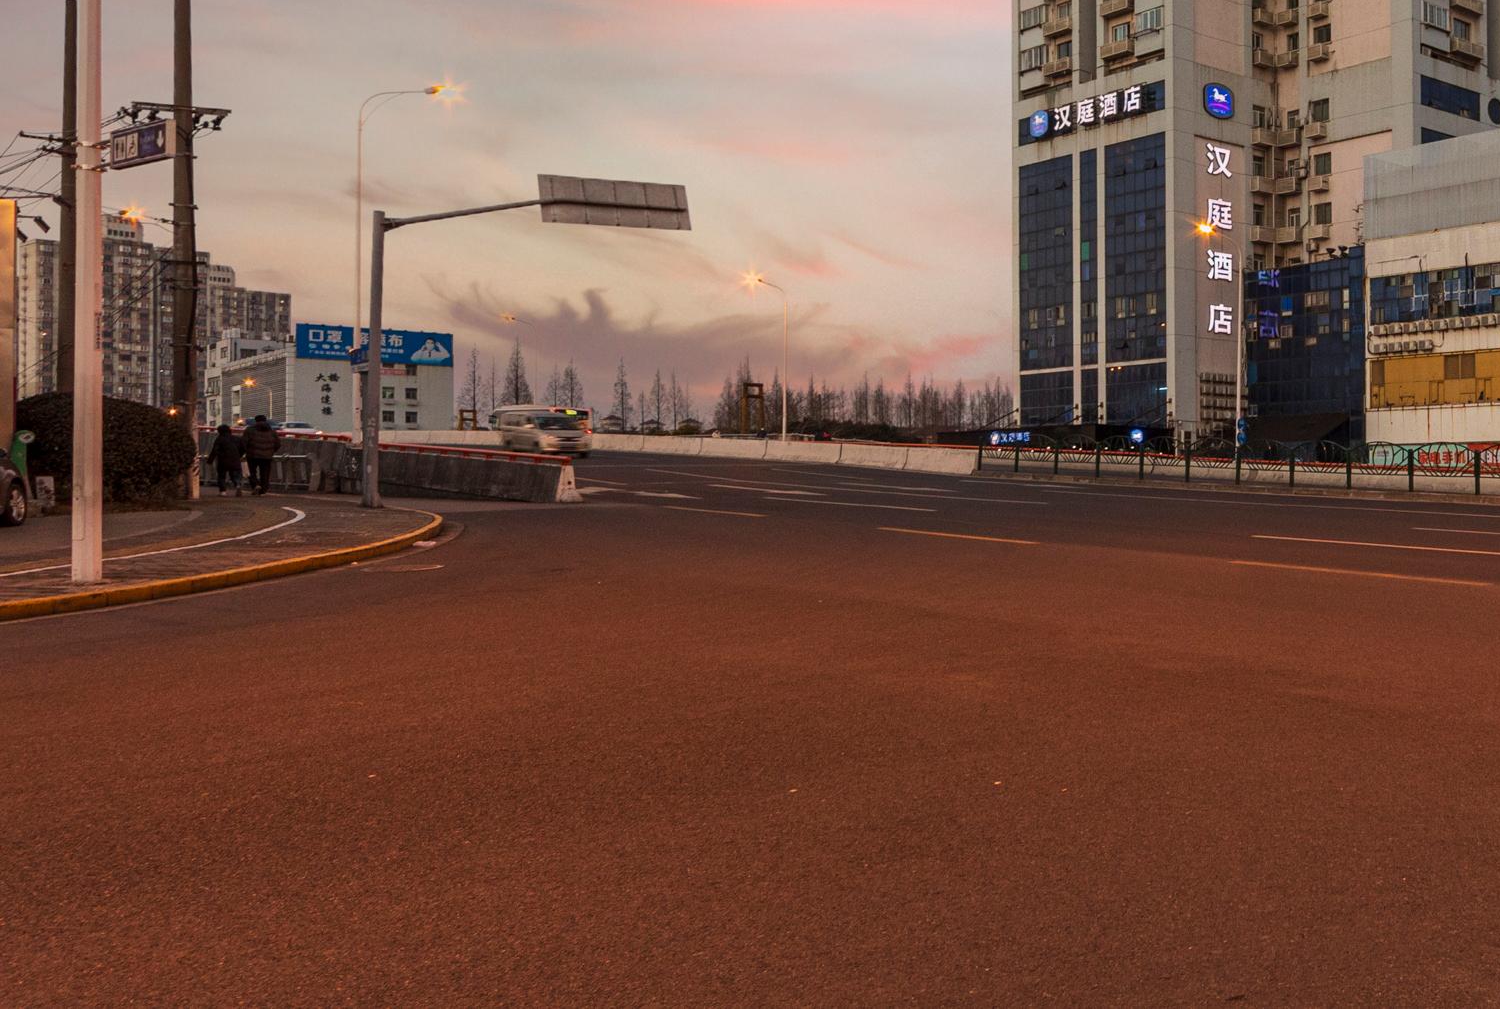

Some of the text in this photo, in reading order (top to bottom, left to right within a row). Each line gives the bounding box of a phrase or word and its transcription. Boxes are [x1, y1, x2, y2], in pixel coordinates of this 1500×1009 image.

[1054, 86, 1141, 131] 汉庭酒店
[1206, 143, 1232, 335] 汉庭酒店
[308, 329, 343, 343] 口罩
